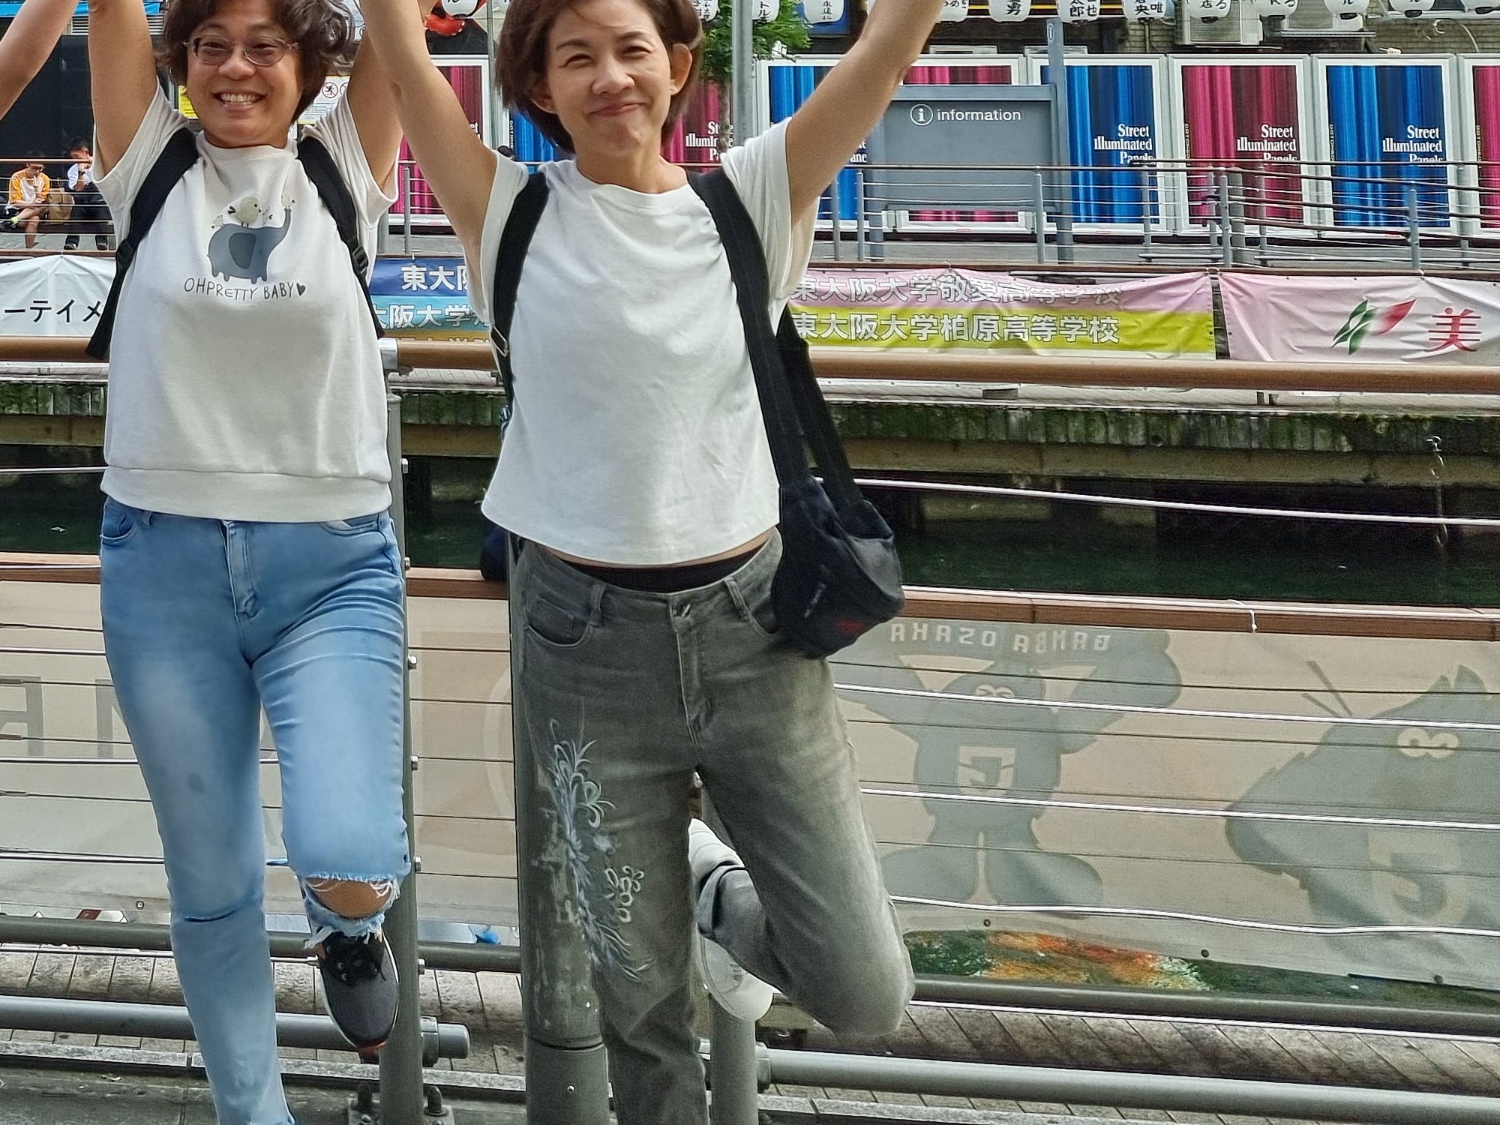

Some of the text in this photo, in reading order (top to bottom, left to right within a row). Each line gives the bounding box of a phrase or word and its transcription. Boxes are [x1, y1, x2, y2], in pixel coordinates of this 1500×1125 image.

[936, 108, 1023, 122] information
[1117, 124, 1150, 139] Street
[1261, 124, 1294, 139] Street
[1406, 124, 1439, 139] Street
[263, 282, 295, 300] BABY
[790, 275, 1123, 305] 東大阪大学敬愛高等学校
[794, 312, 1120, 344] 東大阪大学柏原高等学校
[1424, 307, 1482, 353] 美
